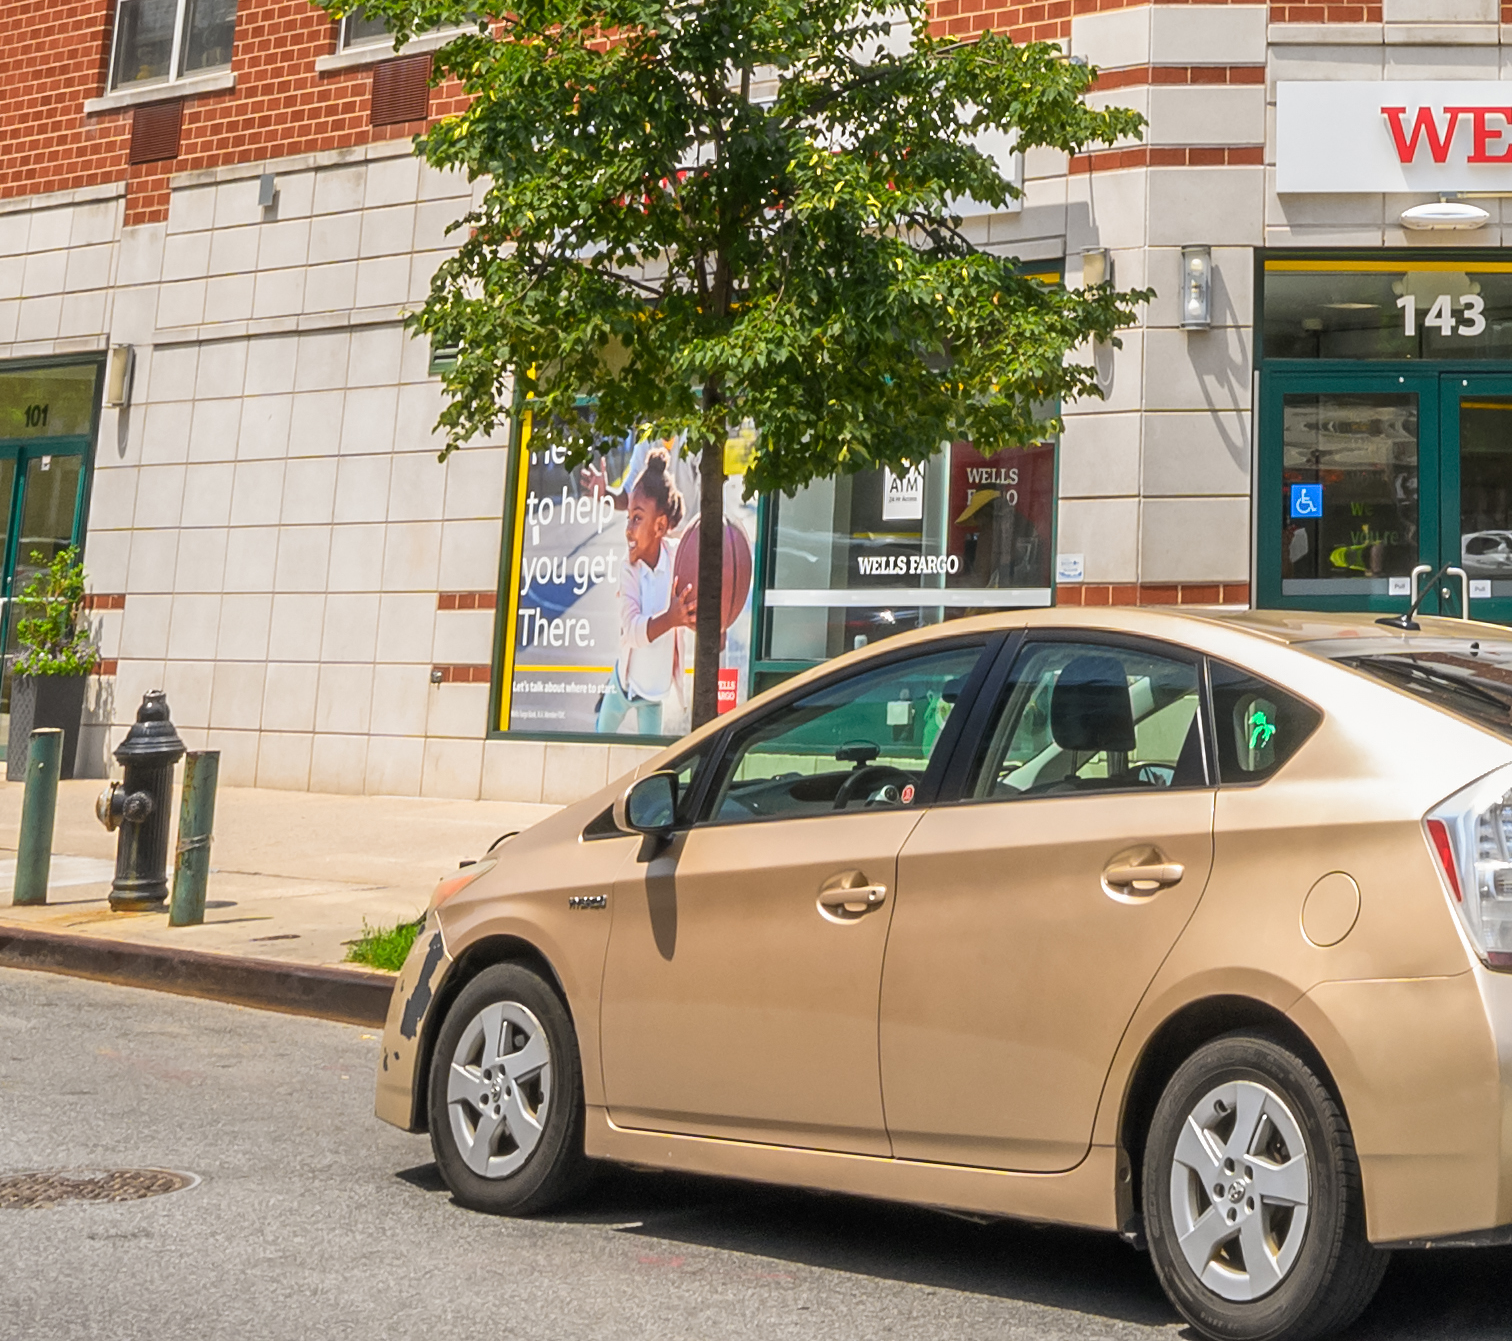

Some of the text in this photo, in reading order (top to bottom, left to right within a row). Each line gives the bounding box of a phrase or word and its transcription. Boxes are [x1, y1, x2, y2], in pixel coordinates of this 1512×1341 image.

[1395, 294, 1487, 337] 143
[24, 403, 49, 428] 101
[966, 467, 1019, 485] WELLS
[526, 484, 614, 534] to help
[519, 548, 618, 597] you get
[857, 554, 960, 576] WELLS FARGO
[1394, 582, 1406, 590] Pull
[1474, 585, 1486, 593] Pull
[517, 607, 596, 647] There.
[512, 680, 618, 694] Let's talk about where to start.
[718, 680, 737, 691] ELLS
